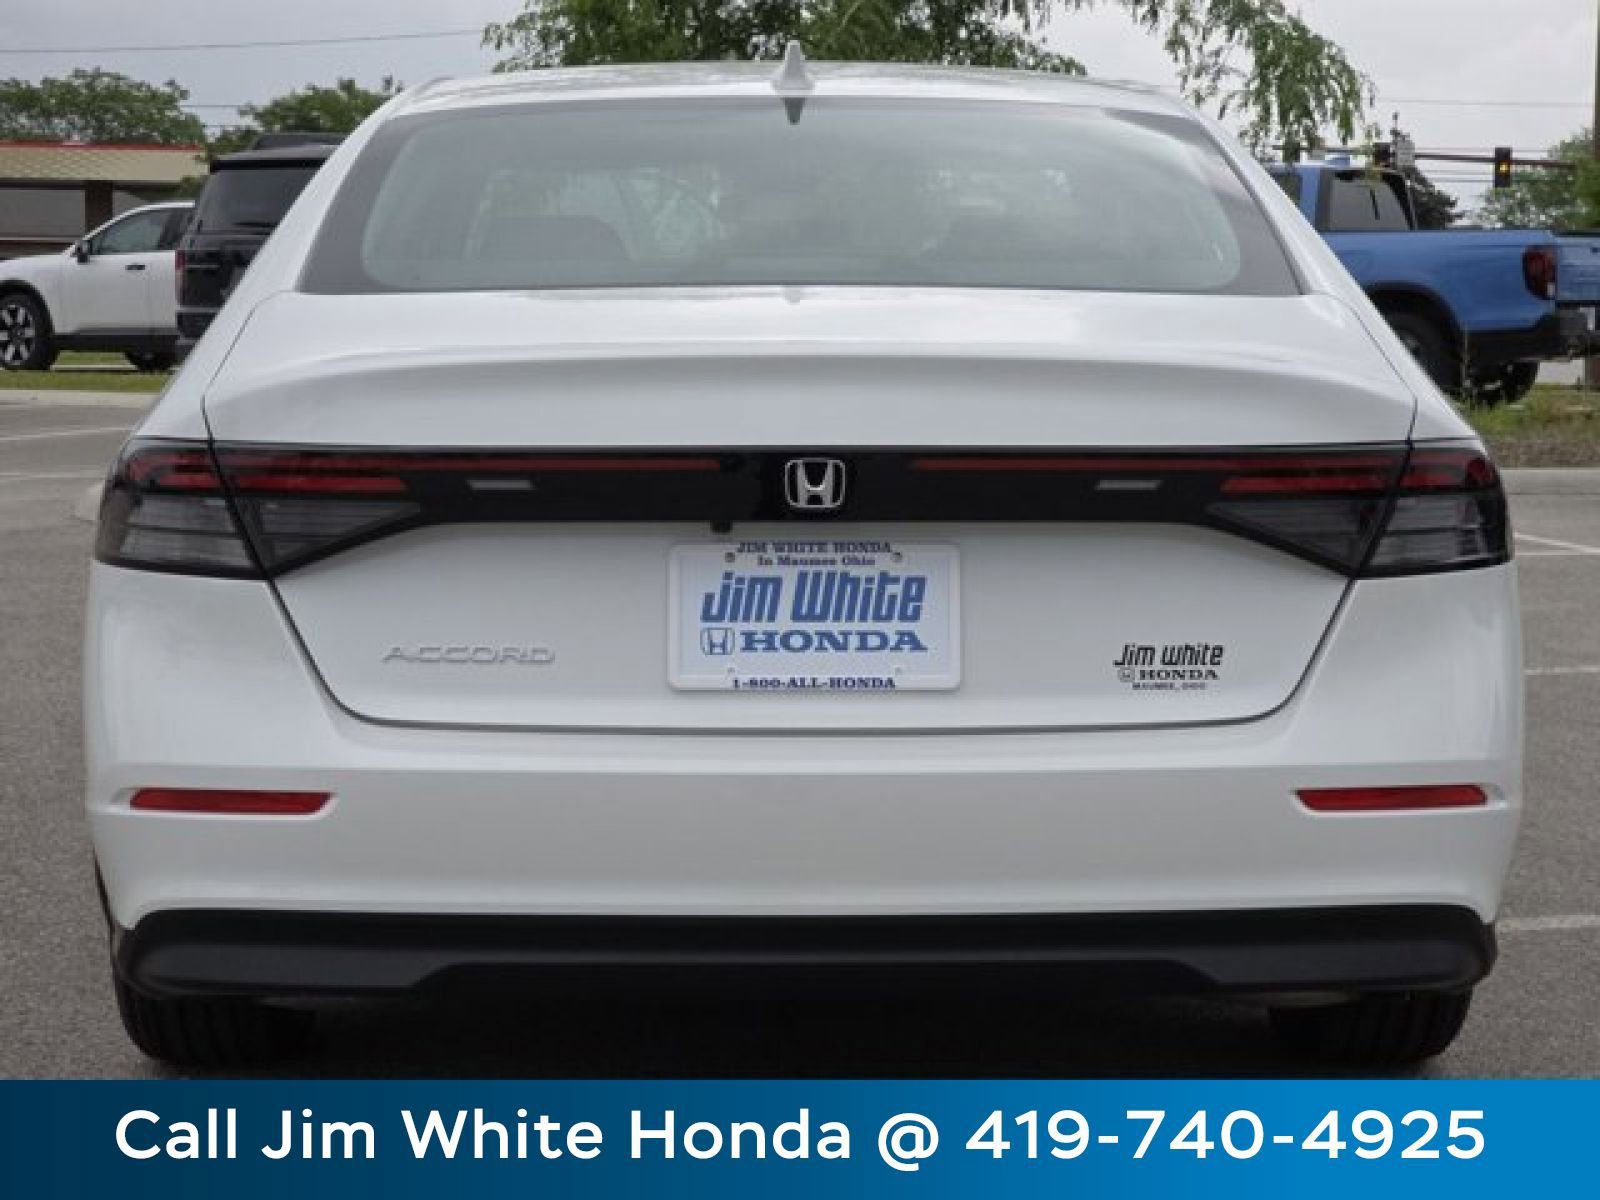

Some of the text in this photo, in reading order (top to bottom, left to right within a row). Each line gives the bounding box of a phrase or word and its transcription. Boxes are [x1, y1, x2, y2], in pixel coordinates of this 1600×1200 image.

[833, 541, 893, 553] HONDA
[790, 570, 927, 623] White
[739, 629, 928, 653] HONDA
[382, 646, 556, 664] ACCORD
[1139, 669, 1220, 681] HONDA
[733, 677, 896, 689] 1-800-ALL-HONDA
